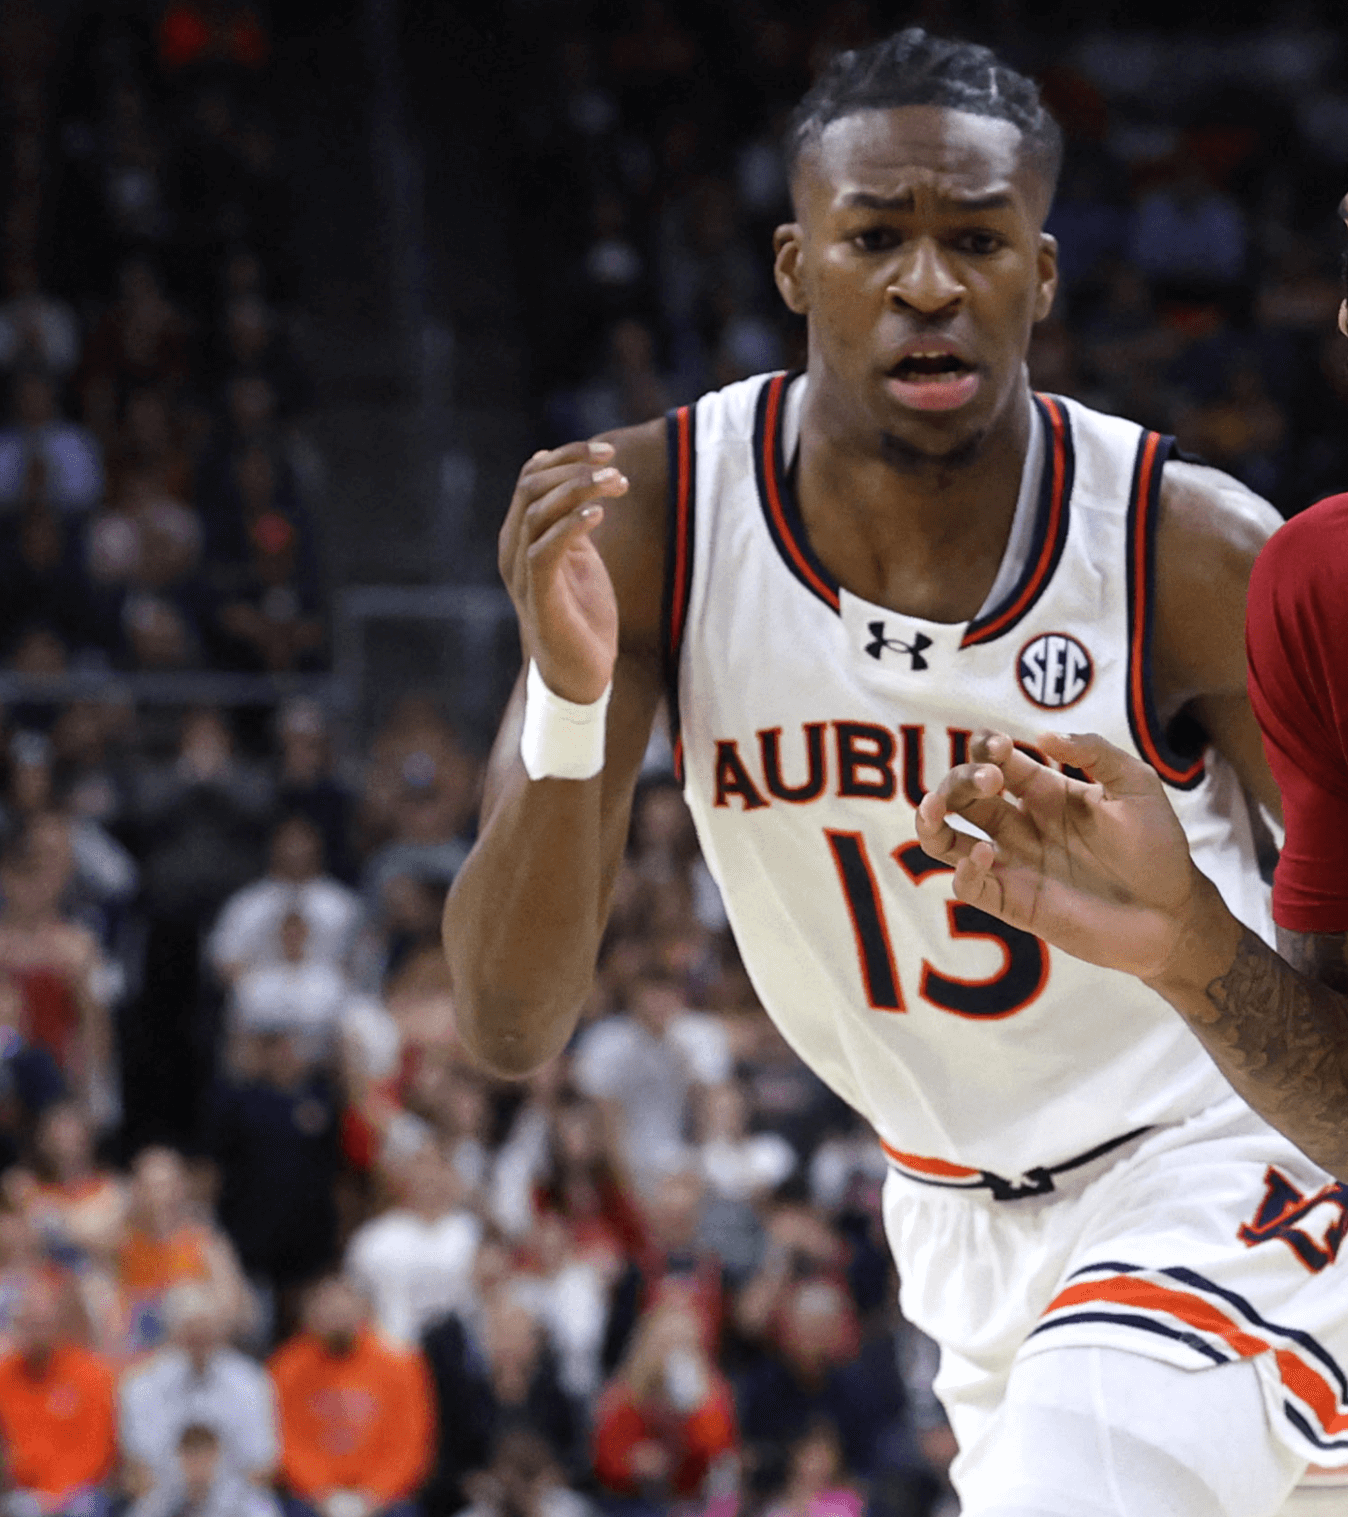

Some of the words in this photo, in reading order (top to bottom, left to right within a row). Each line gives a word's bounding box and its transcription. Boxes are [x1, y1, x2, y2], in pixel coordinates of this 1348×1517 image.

[1021, 636, 1090, 706] SEC
[712, 720, 1095, 811] AUBU
[823, 827, 1052, 1021] 13
